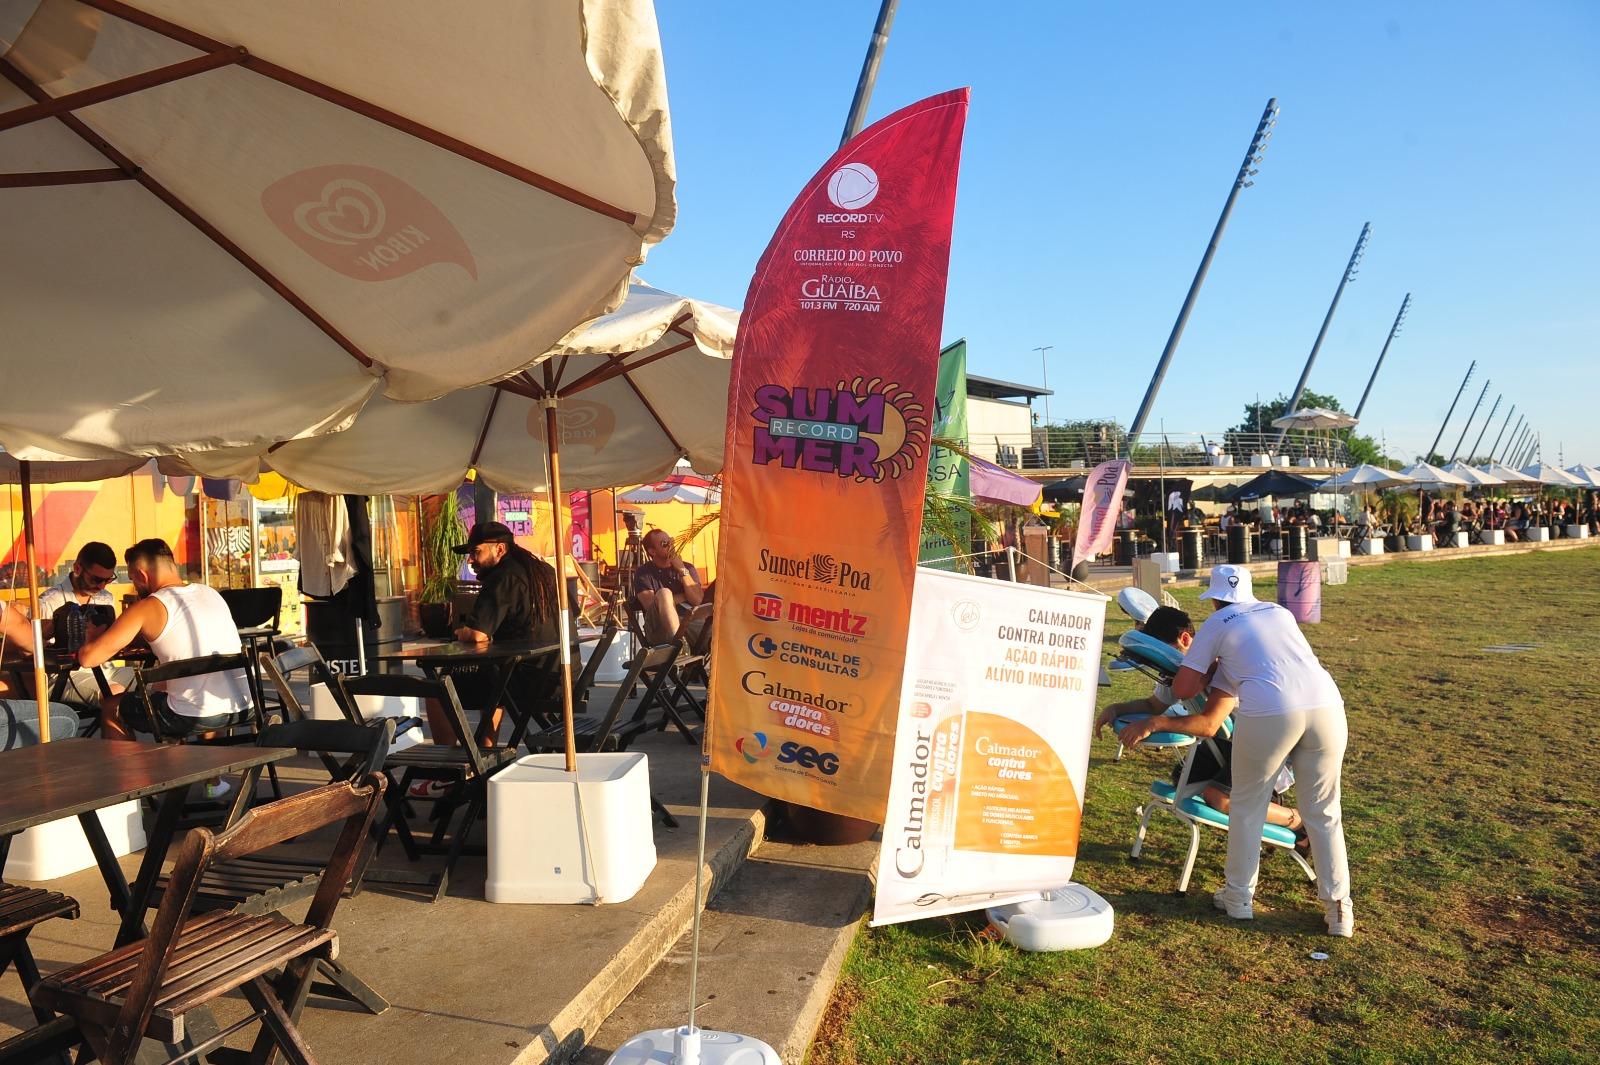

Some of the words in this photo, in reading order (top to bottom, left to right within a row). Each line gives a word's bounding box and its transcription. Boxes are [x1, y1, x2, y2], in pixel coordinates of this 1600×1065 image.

[841, 230, 856, 239] RS
[794, 249, 845, 262] CORREIO
[848, 249, 866, 262] DO
[869, 250, 903, 263] POVO
[801, 279, 880, 300] GUAÍBA
[800, 301, 821, 310] 101.3
[822, 302, 837, 310] FM
[844, 302, 860, 311] 720
[862, 303, 880, 312] AM
[772, 420, 854, 441] RECORD
[758, 548, 811, 580] Sunset
[838, 562, 871, 591] Poa
[753, 596, 782, 619] CR
[788, 602, 868, 637] mentz
[1029, 609, 1092, 631] CALMADOR
[998, 625, 1044, 645] CONTRA
[781, 641, 838, 662] CENTRAL
[842, 654, 861, 666] DE
[1005, 646, 1037, 667] AÇÃO
[779, 653, 859, 678] CONSULTAS
[985, 664, 1024, 684] ALÍVIO
[741, 670, 850, 714] Calmador
[769, 699, 822, 721] contra
[784, 714, 832, 736] dores
[975, 736, 1038, 759] Calmador
[987, 756, 1026, 769] contra
[997, 767, 1033, 781] dores
[895, 729, 931, 879] Calmador
